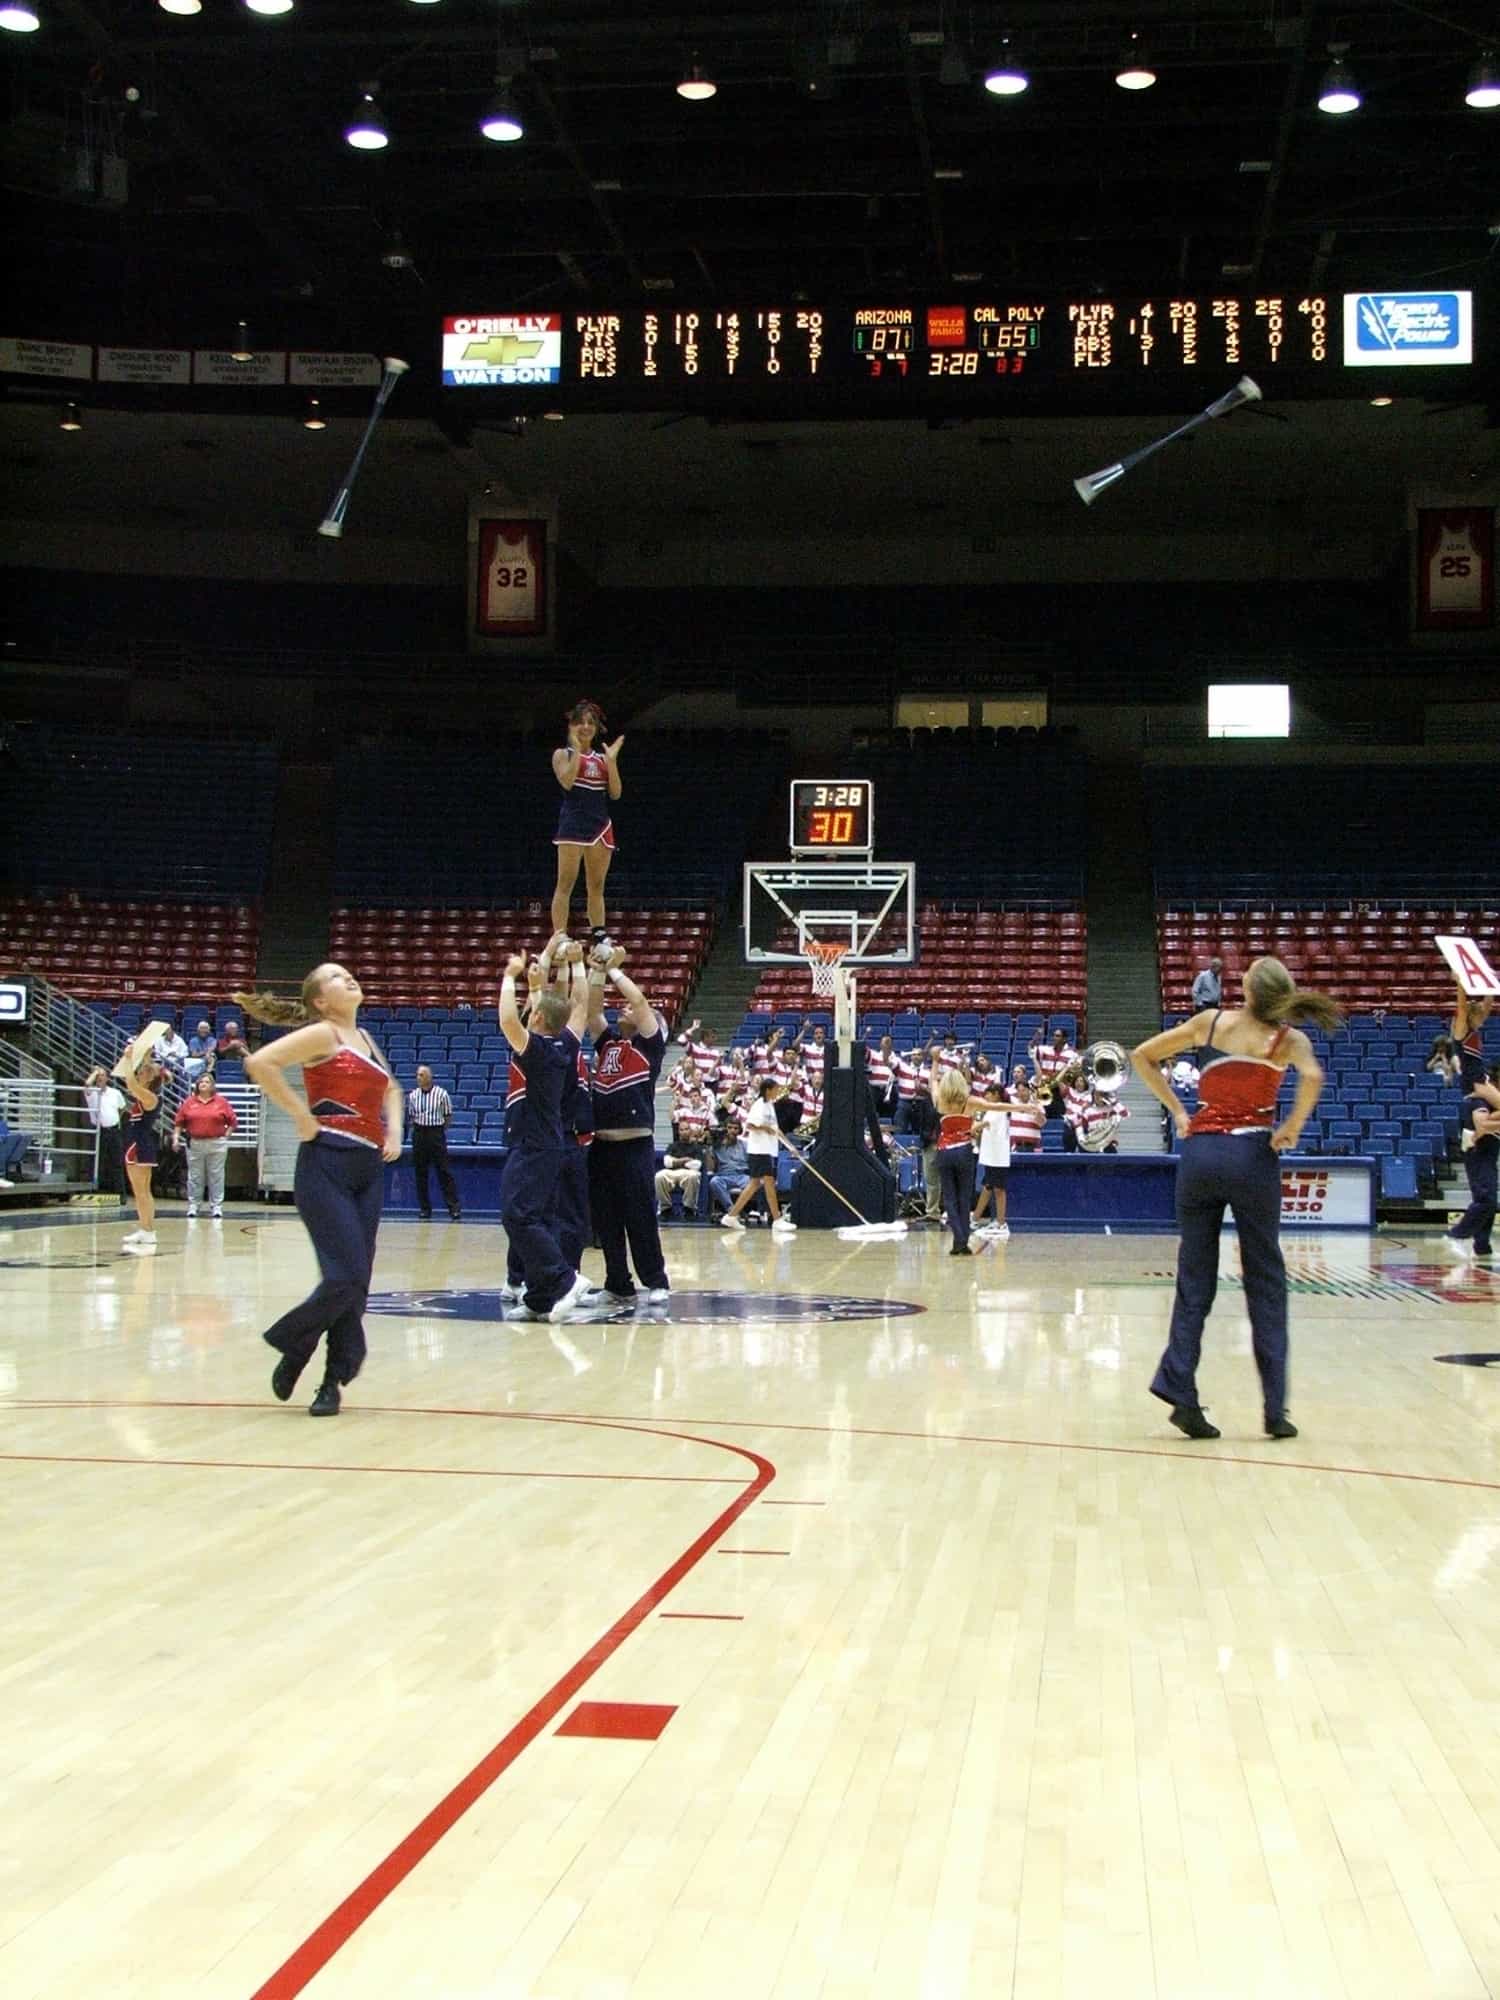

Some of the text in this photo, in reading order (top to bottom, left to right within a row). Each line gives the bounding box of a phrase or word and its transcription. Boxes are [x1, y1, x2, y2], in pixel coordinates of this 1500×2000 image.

[855, 310, 912, 324] ARIZONA
[974, 307, 1044, 322] CAL POLY
[1069, 298, 1325, 321] PLYR 4 20 22 25 40
[454, 318, 550, 334] O'RIELLY
[577, 312, 822, 332] PLYR 2 10 14 15 20
[928, 319, 964, 327] WELLS
[930, 327, 963, 336] FARGO
[1077, 320, 1108, 336] PTS
[1269, 315, 1282, 330] 0
[1311, 314, 1325, 330] 0
[584, 332, 614, 346] PTS
[645, 331, 657, 345] 0
[767, 329, 780, 344] 0
[809, 328, 822, 343] 7
[871, 329, 901, 350] 87
[998, 327, 1027, 347] 65
[1074, 336, 1110, 352] RBS
[1140, 334, 1153, 350] 3
[1225, 331, 1239, 348] 4
[1269, 331, 1282, 346] 0
[581, 347, 616, 362] RBS
[685, 344, 698, 360] 5
[726, 344, 739, 360] 3
[809, 343, 821, 359] 3
[1074, 351, 1111, 367] FLS
[1183, 348, 1196, 364] 2
[1225, 347, 1239, 363] 2
[1311, 345, 1325, 361] 0
[580, 363, 616, 377] FLS
[644, 361, 657, 376] 2
[685, 360, 698, 375] 0
[767, 359, 780, 374] 0
[928, 353, 979, 376] 3:28
[454, 369, 550, 384] WATSON
[1440, 555, 1472, 578] 25
[497, 567, 528, 588] 32
[813, 787, 862, 807] 3:28
[809, 813, 853, 843] 30
[1454, 943, 1497, 989] A
[124, 980, 136, 992] 19
